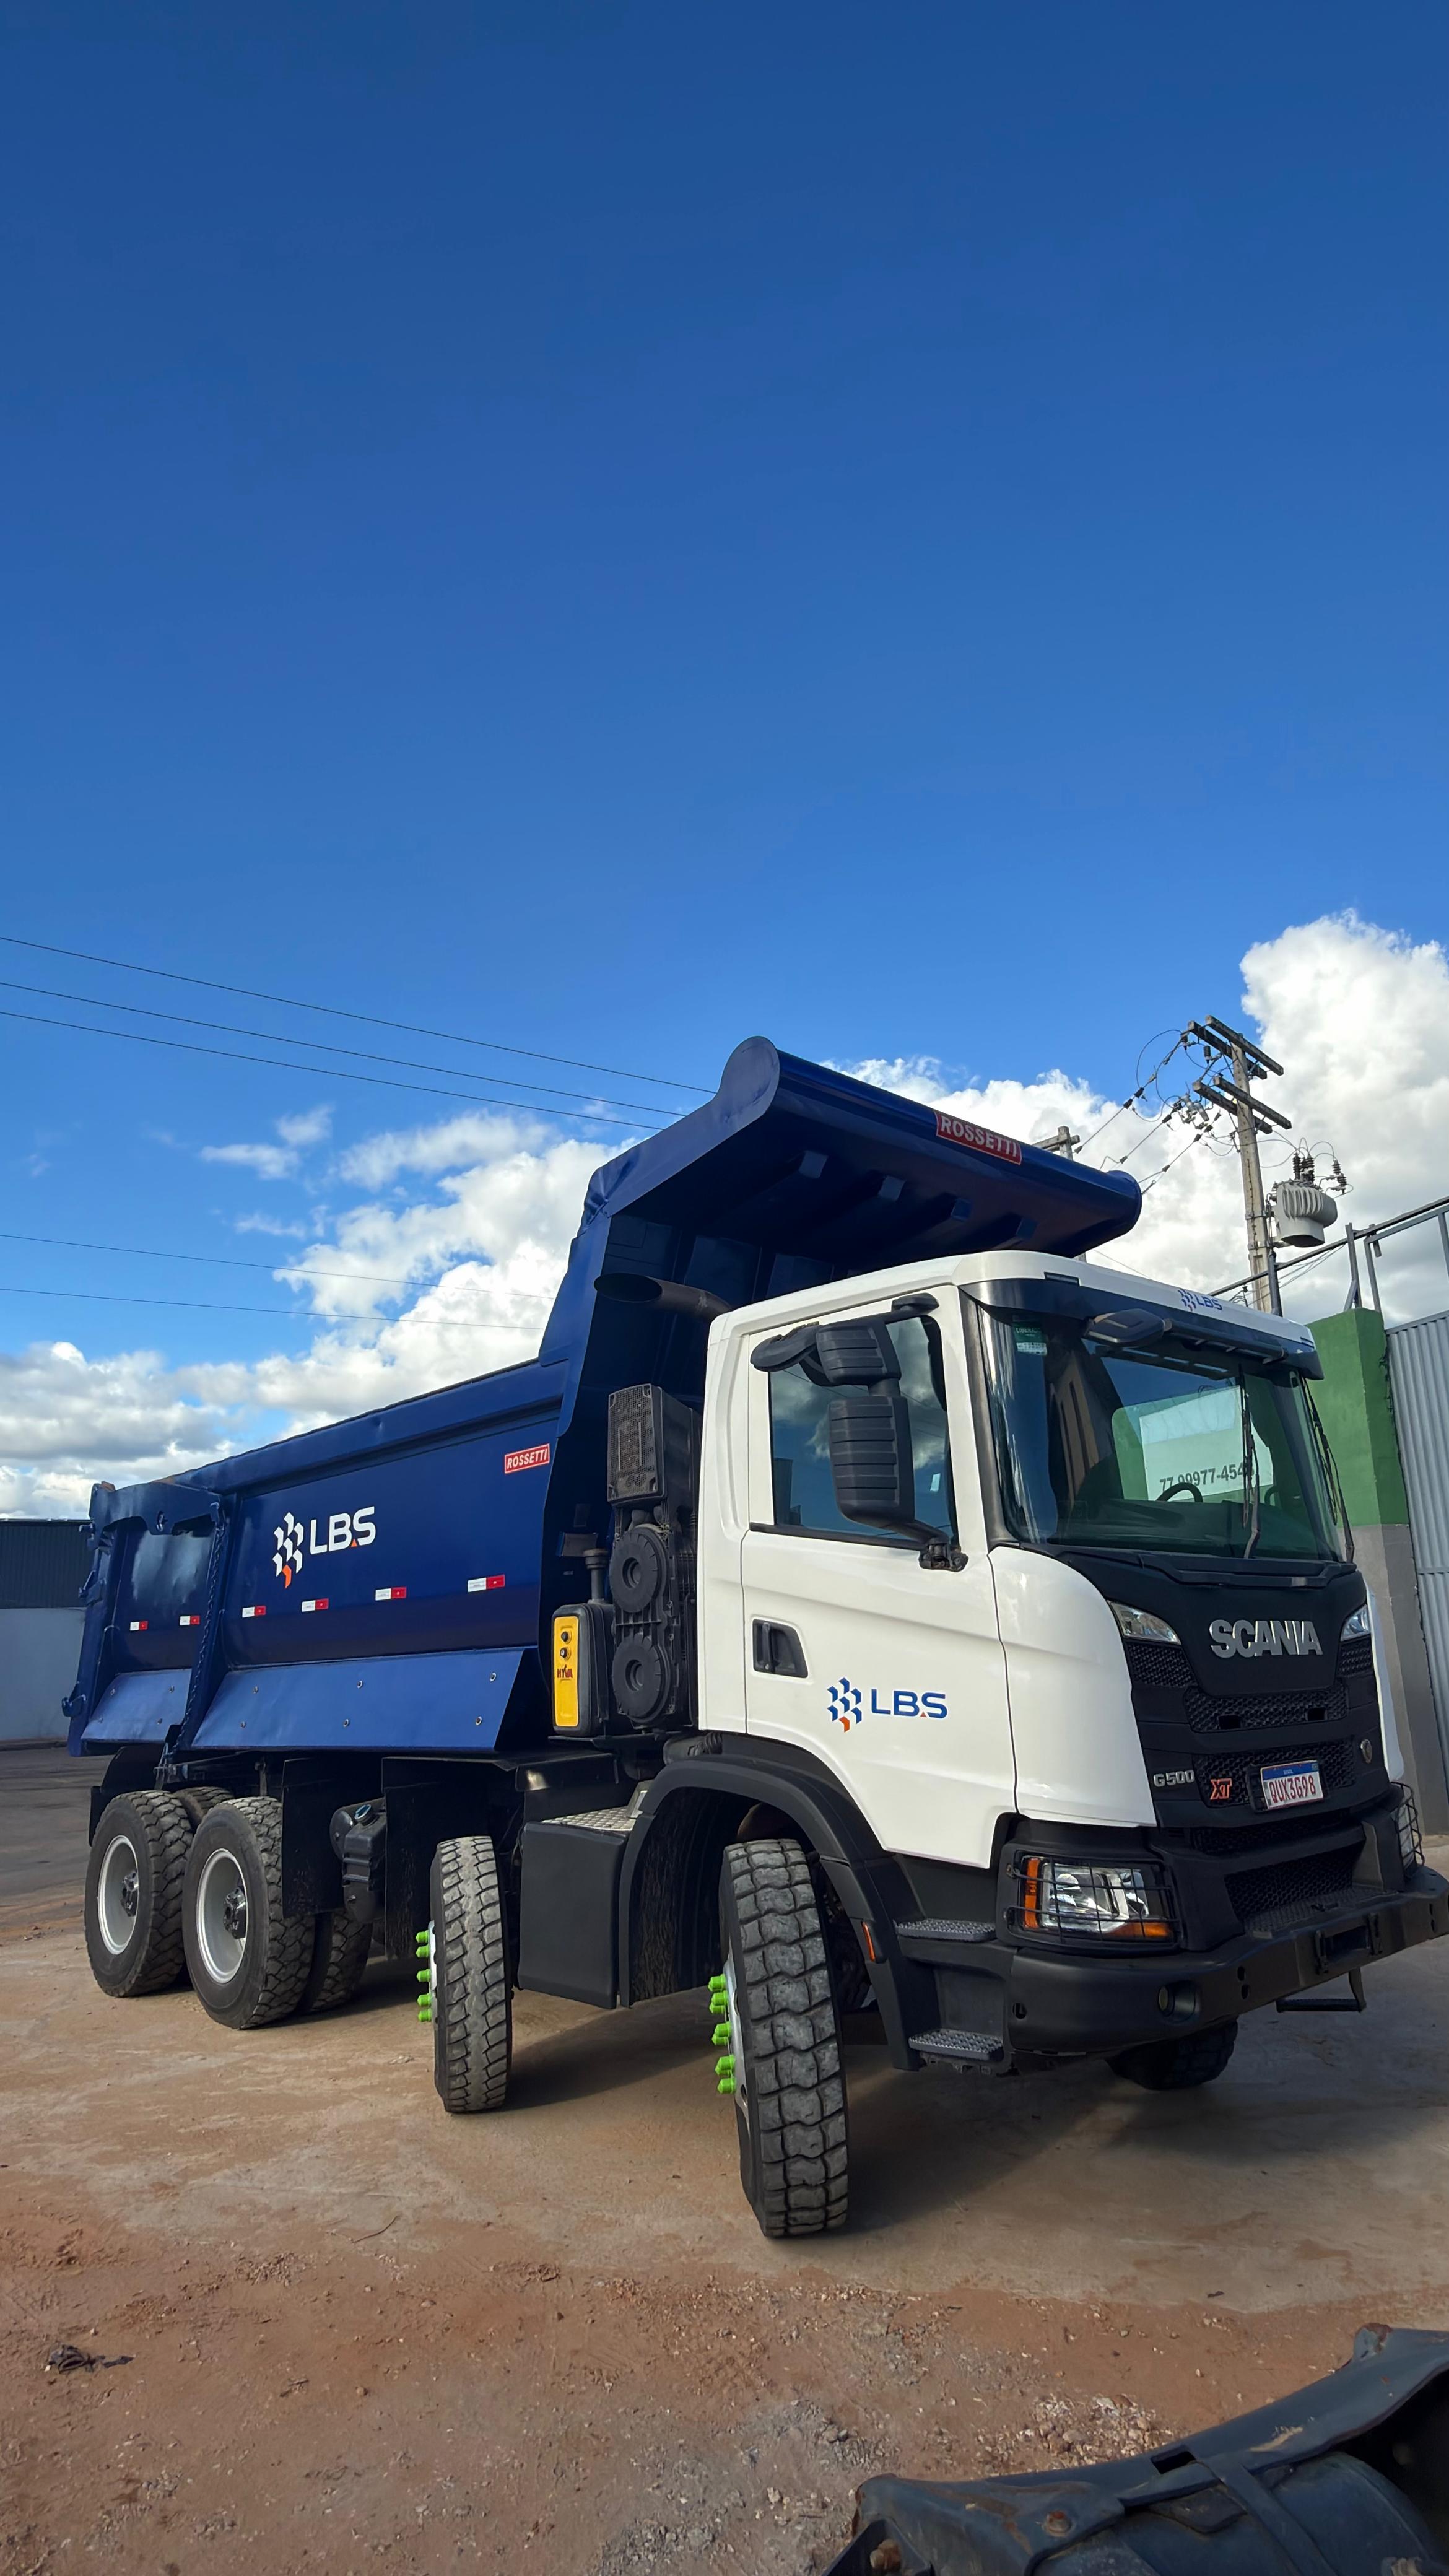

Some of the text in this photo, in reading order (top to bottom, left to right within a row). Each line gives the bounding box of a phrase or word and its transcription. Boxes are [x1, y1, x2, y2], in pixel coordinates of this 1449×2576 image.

[941, 1115, 1017, 1157] ROSSETTI
[1194, 1294, 1222, 1310] LBS
[507, 1448, 547, 1469] ROSSETTI
[1178, 1461, 1255, 1486] 99977-454
[310, 1506, 376, 1555] LBS
[1209, 1619, 1323, 1658] SCANIA
[557, 1664, 573, 1679] HYVA
[871, 1689, 947, 1718] LBS
[1154, 1770, 1195, 1787] G500
[1210, 1778, 1232, 1800] XT
[1269, 1775, 1316, 1803] QUX3G98
